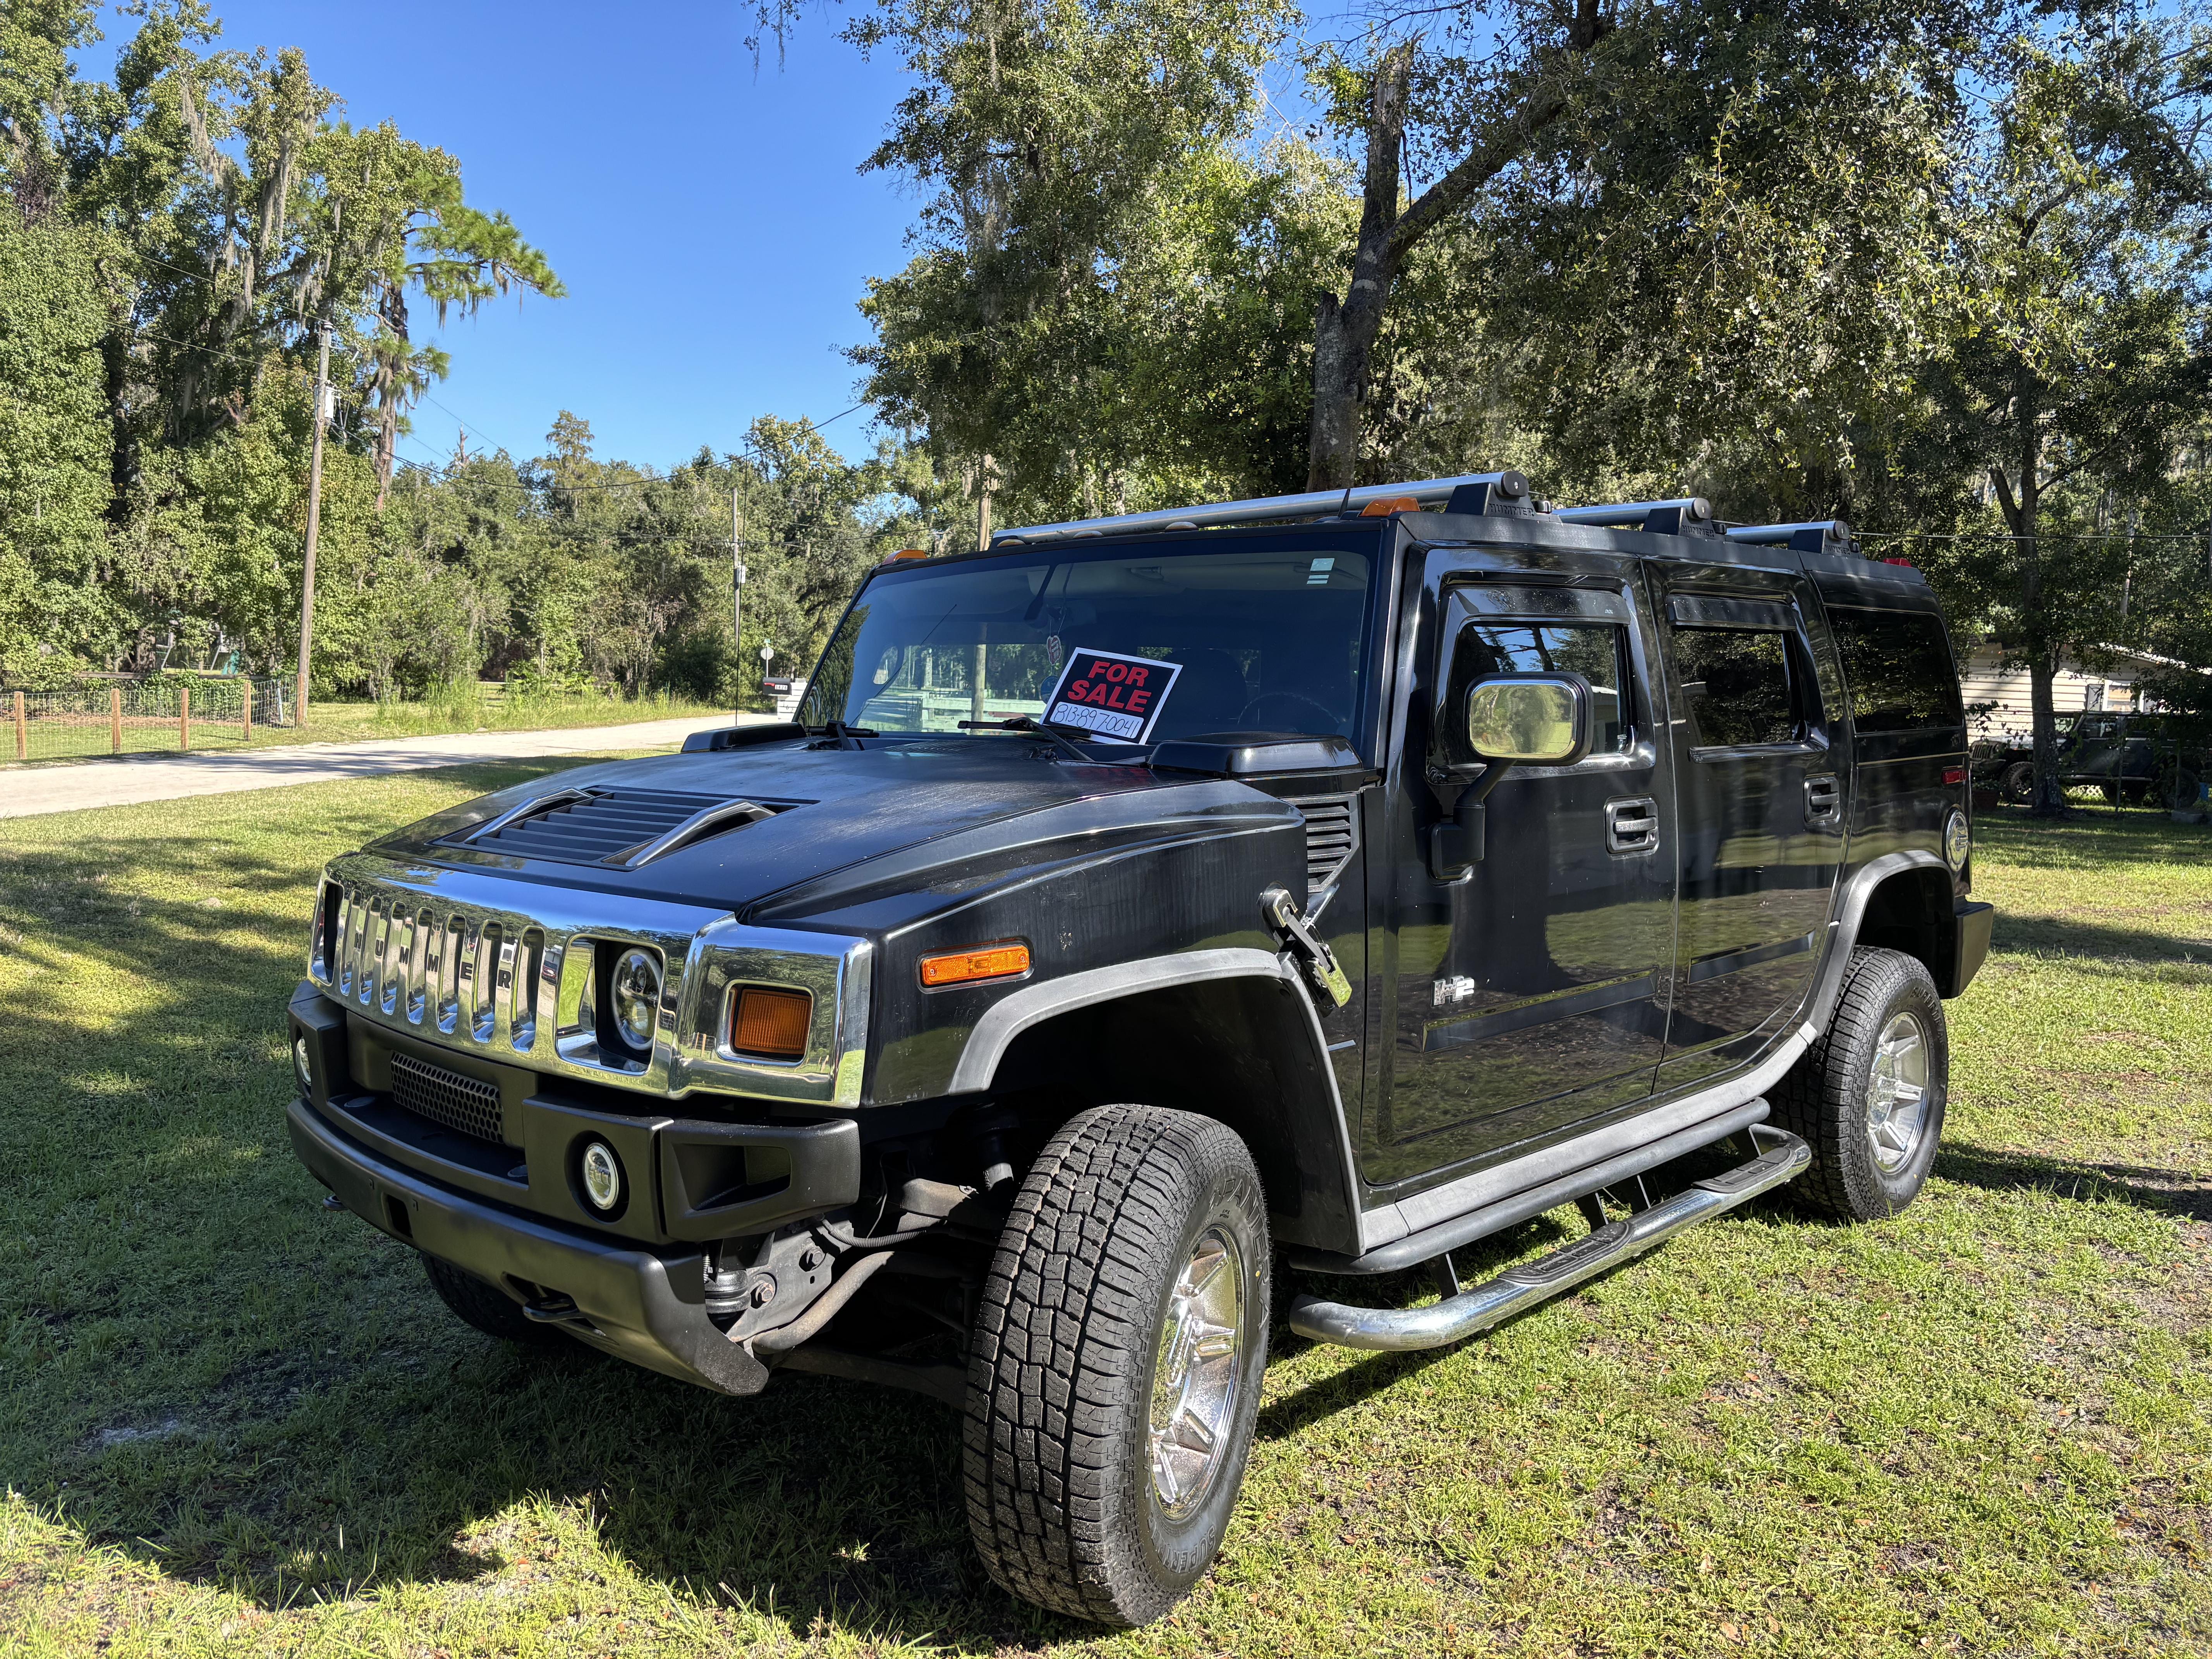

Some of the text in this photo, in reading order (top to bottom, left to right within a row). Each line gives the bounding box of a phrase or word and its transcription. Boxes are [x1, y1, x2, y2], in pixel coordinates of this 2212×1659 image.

[1488, 503, 1534, 517] HUMMER
[1681, 525, 1714, 537] HUMMER
[1825, 543, 1850, 555] HUMMER
[1087, 660, 1149, 687] FOR
[1067, 680, 1152, 713] SALE
[354, 932, 512, 989] HUMMER
[1431, 975, 1475, 1007] H2
